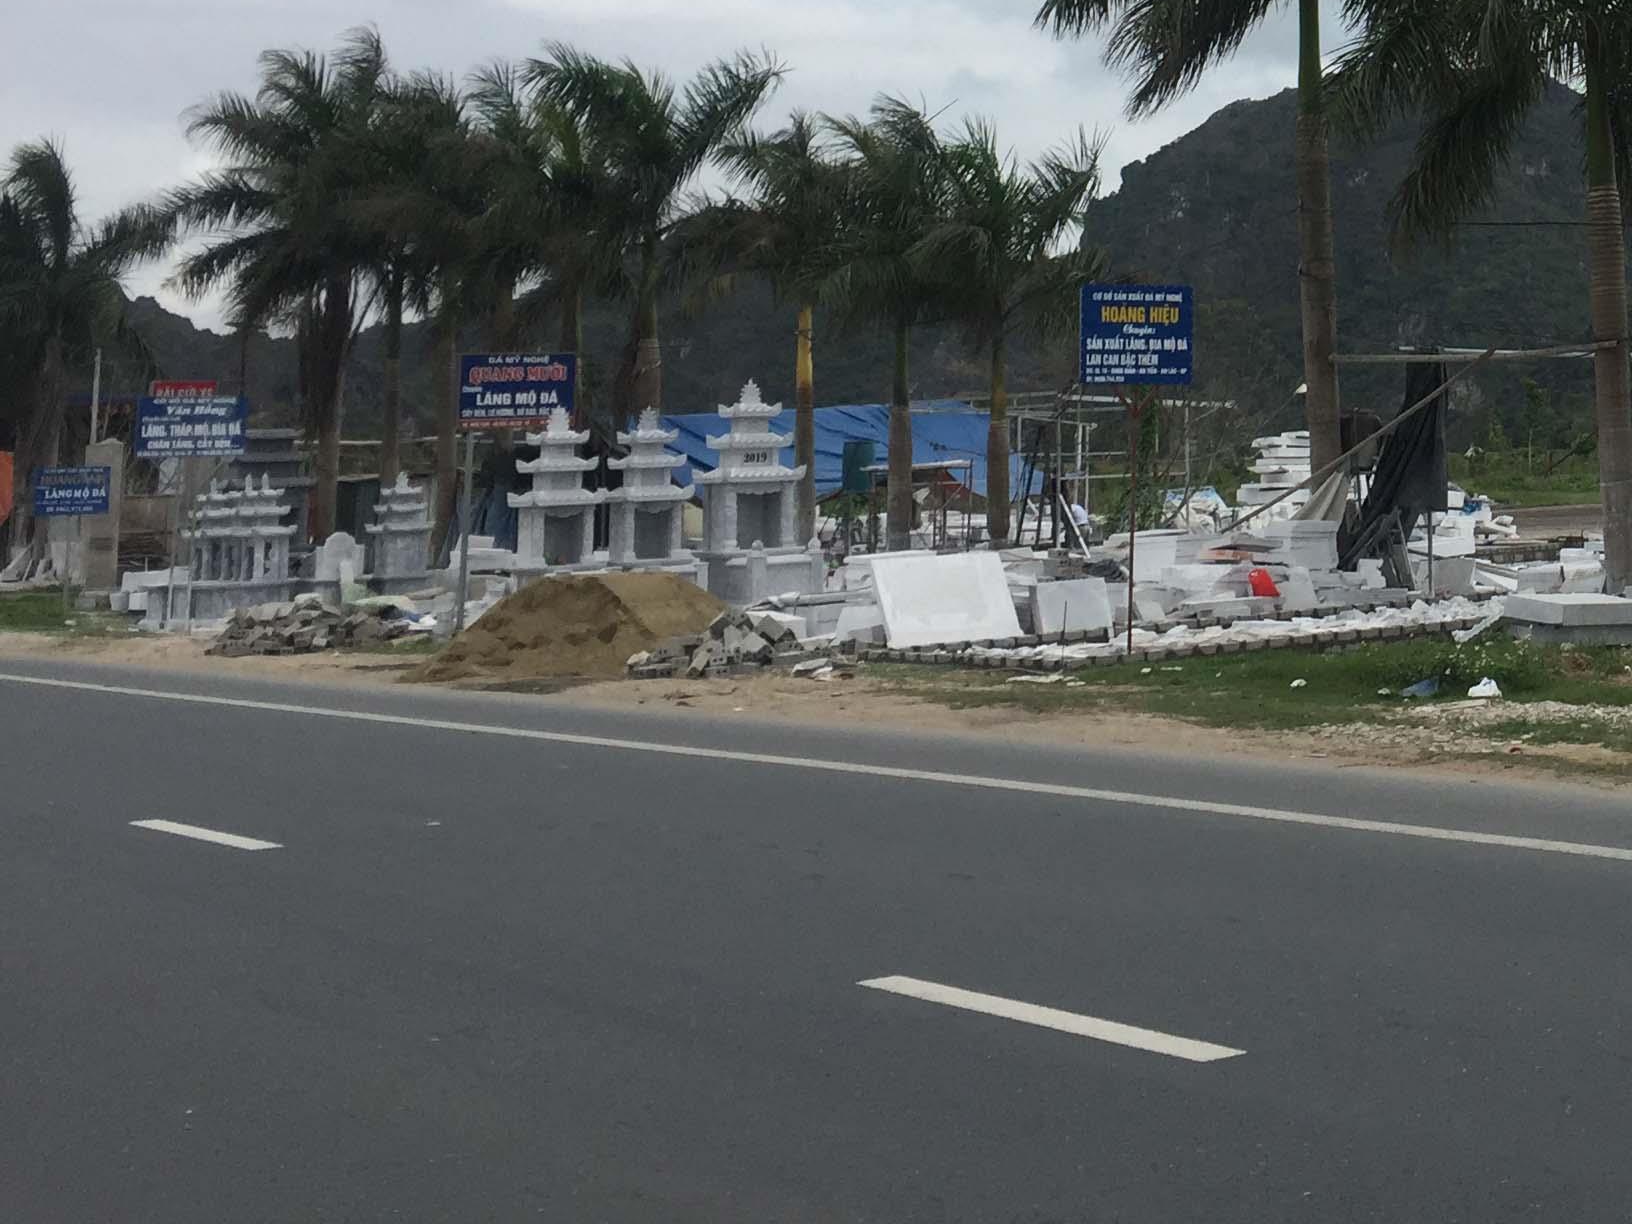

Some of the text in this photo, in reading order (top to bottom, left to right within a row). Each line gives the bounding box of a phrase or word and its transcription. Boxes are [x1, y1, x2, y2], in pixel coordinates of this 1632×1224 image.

[1149, 304, 1179, 326] HIỆU
[469, 365, 525, 385] QUANG
[540, 390, 558, 405] ĐÁ
[743, 452, 768, 463] 2019
